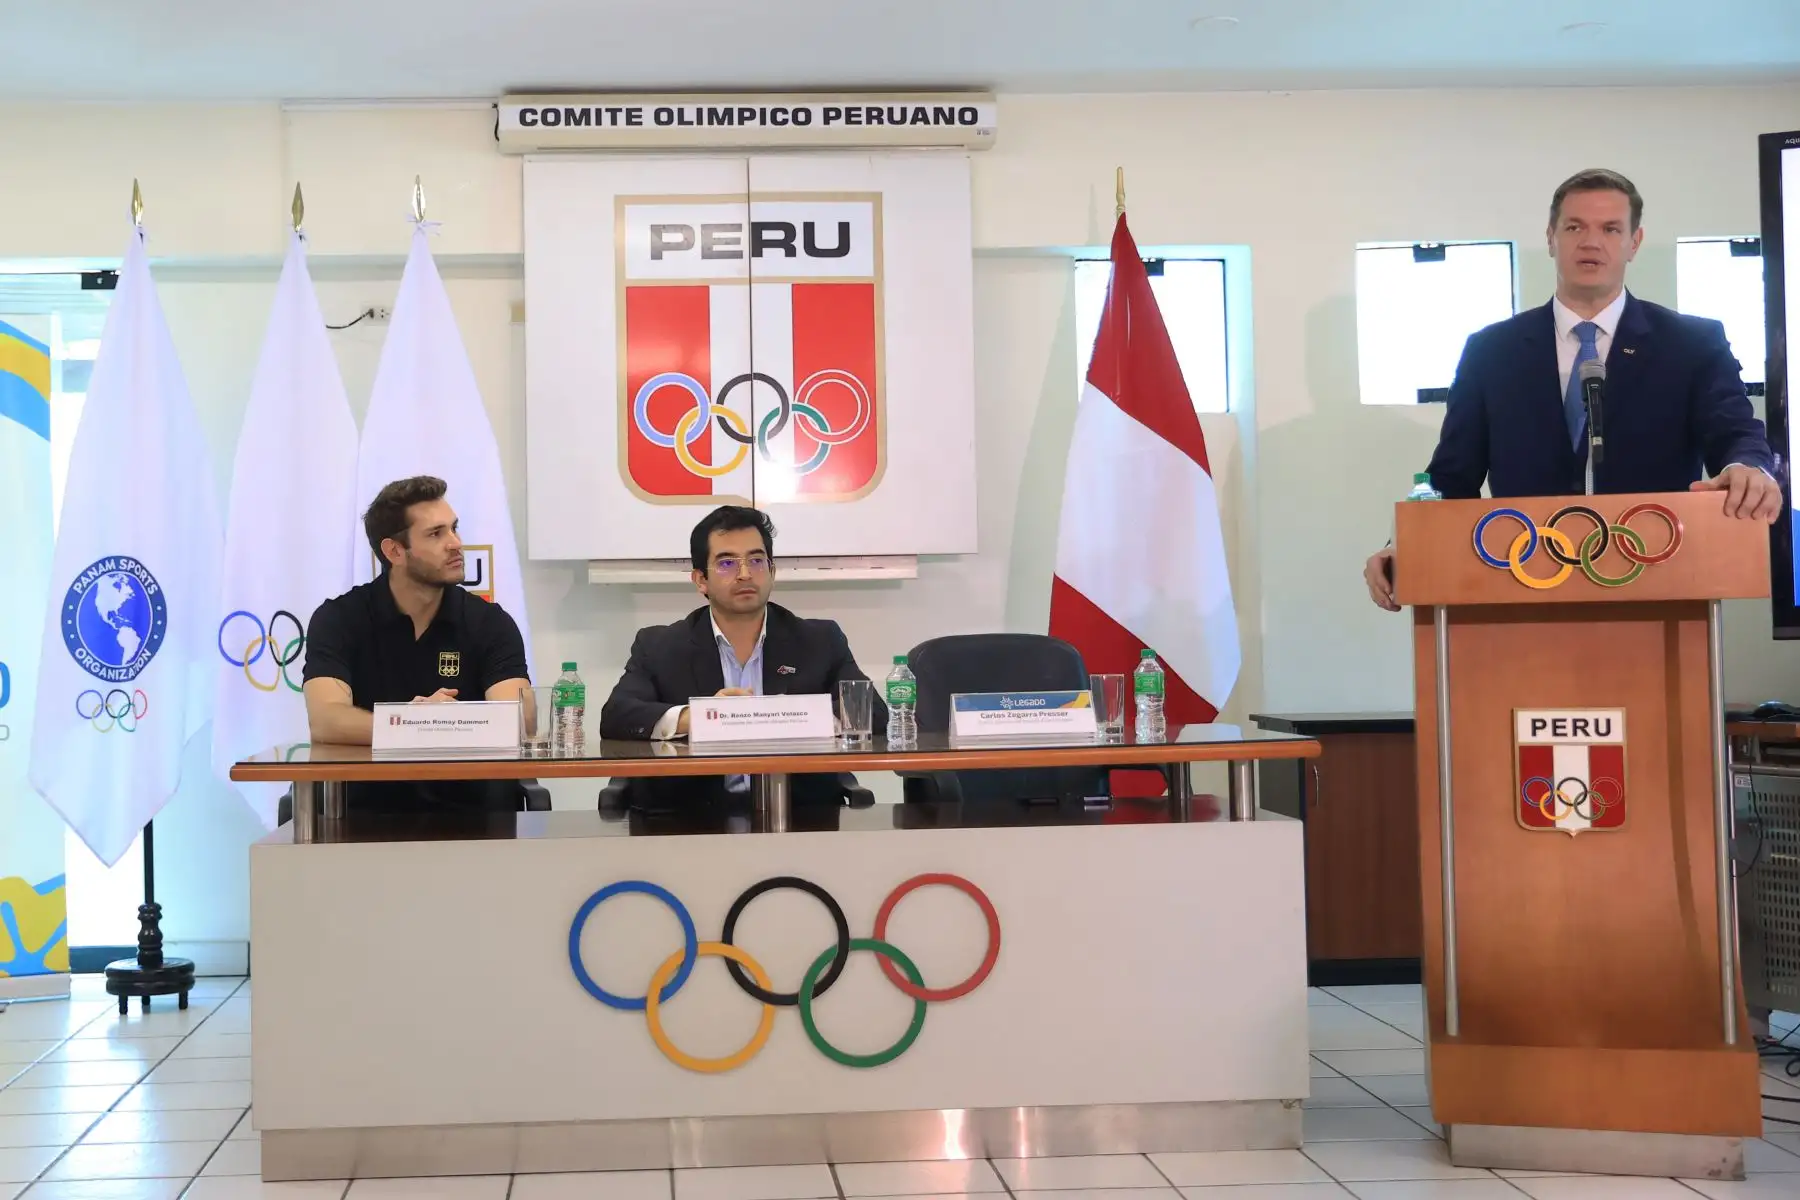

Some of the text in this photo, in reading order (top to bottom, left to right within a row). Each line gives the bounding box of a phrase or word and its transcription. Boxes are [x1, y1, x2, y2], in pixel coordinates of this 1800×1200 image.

[519, 106, 979, 127] COMITE OLIMPICO PERUANO
[650, 221, 850, 260] PERU
[73, 559, 158, 595] PANAM SPORTS
[1007, 711, 1038, 720] Zegarra
[1531, 718, 1611, 737] PERU
